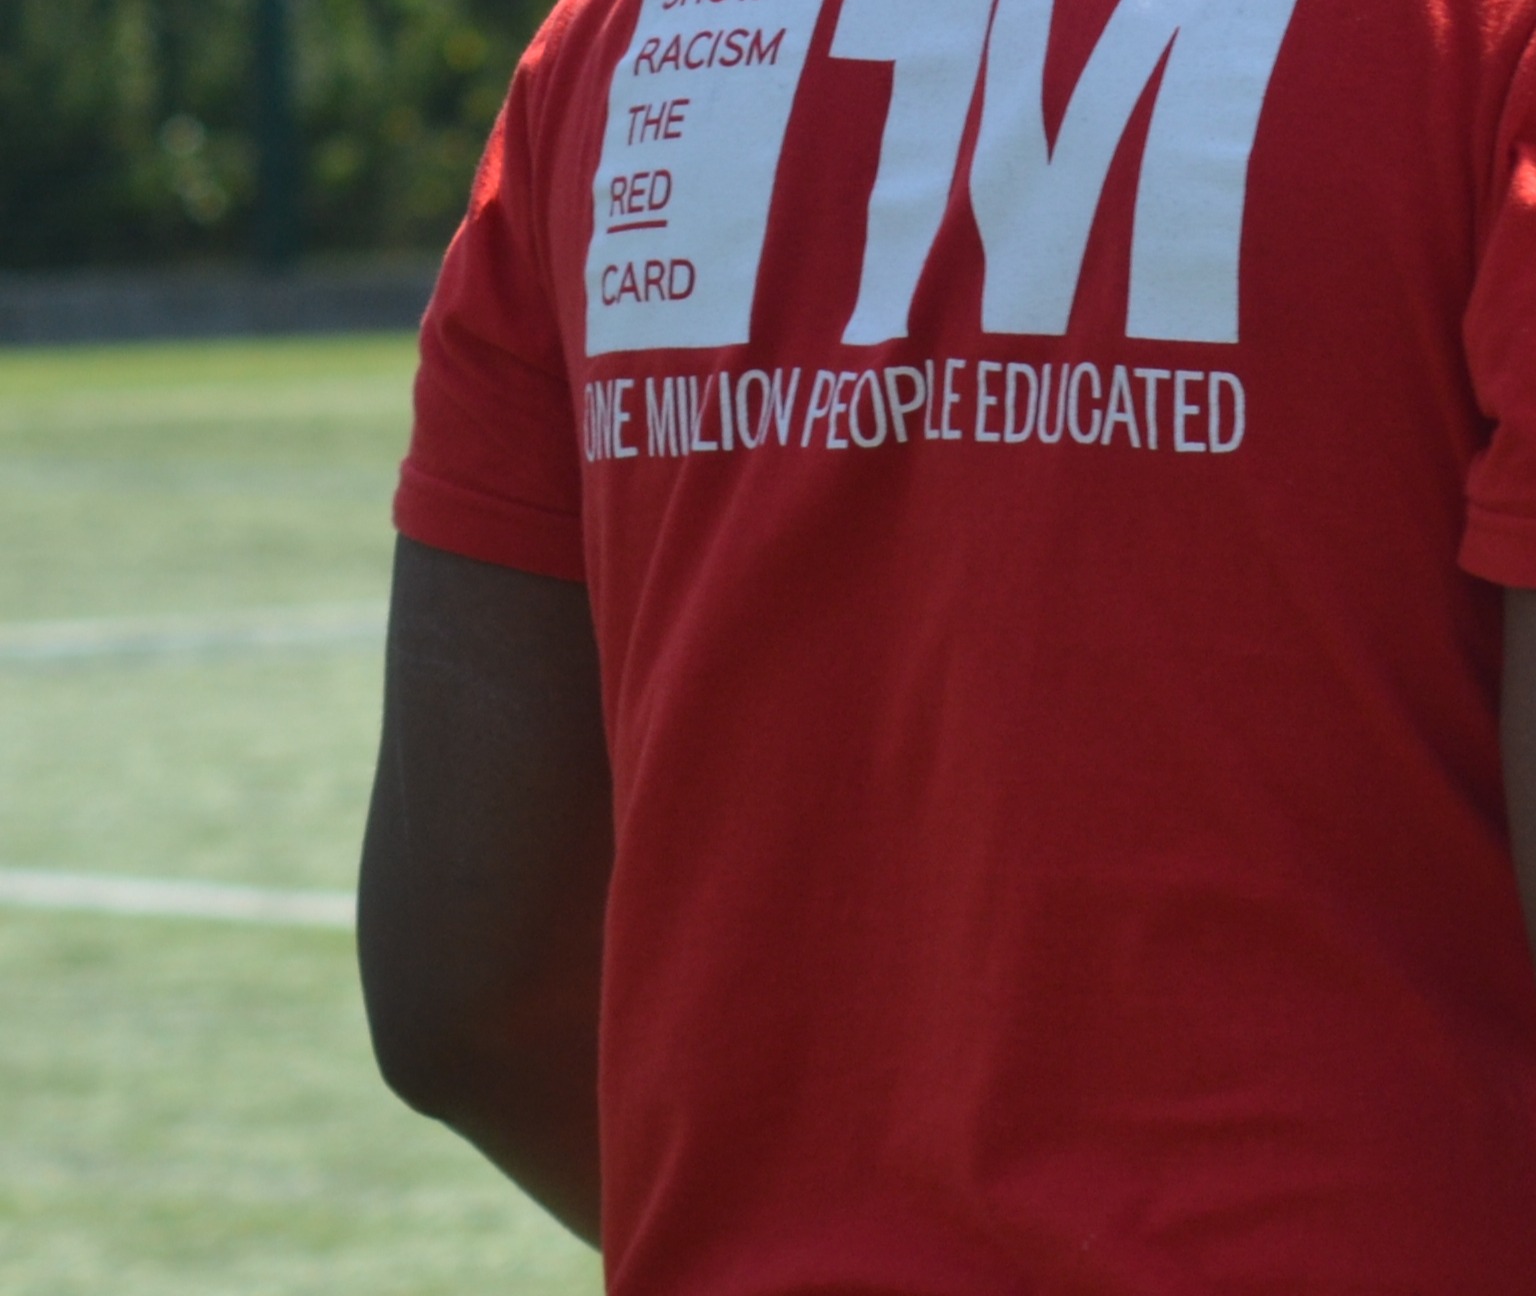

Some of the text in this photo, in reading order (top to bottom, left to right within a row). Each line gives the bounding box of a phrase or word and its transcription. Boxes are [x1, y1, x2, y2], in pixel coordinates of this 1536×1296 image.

[633, 28, 787, 76] RACISM
[627, 98, 690, 146] THE
[609, 169, 673, 217] RED
[602, 259, 696, 306] CARD
[585, 378, 639, 462] ONE
[801, 358, 966, 450] PEOPLE
[975, 361, 1246, 453] EDUCATED
